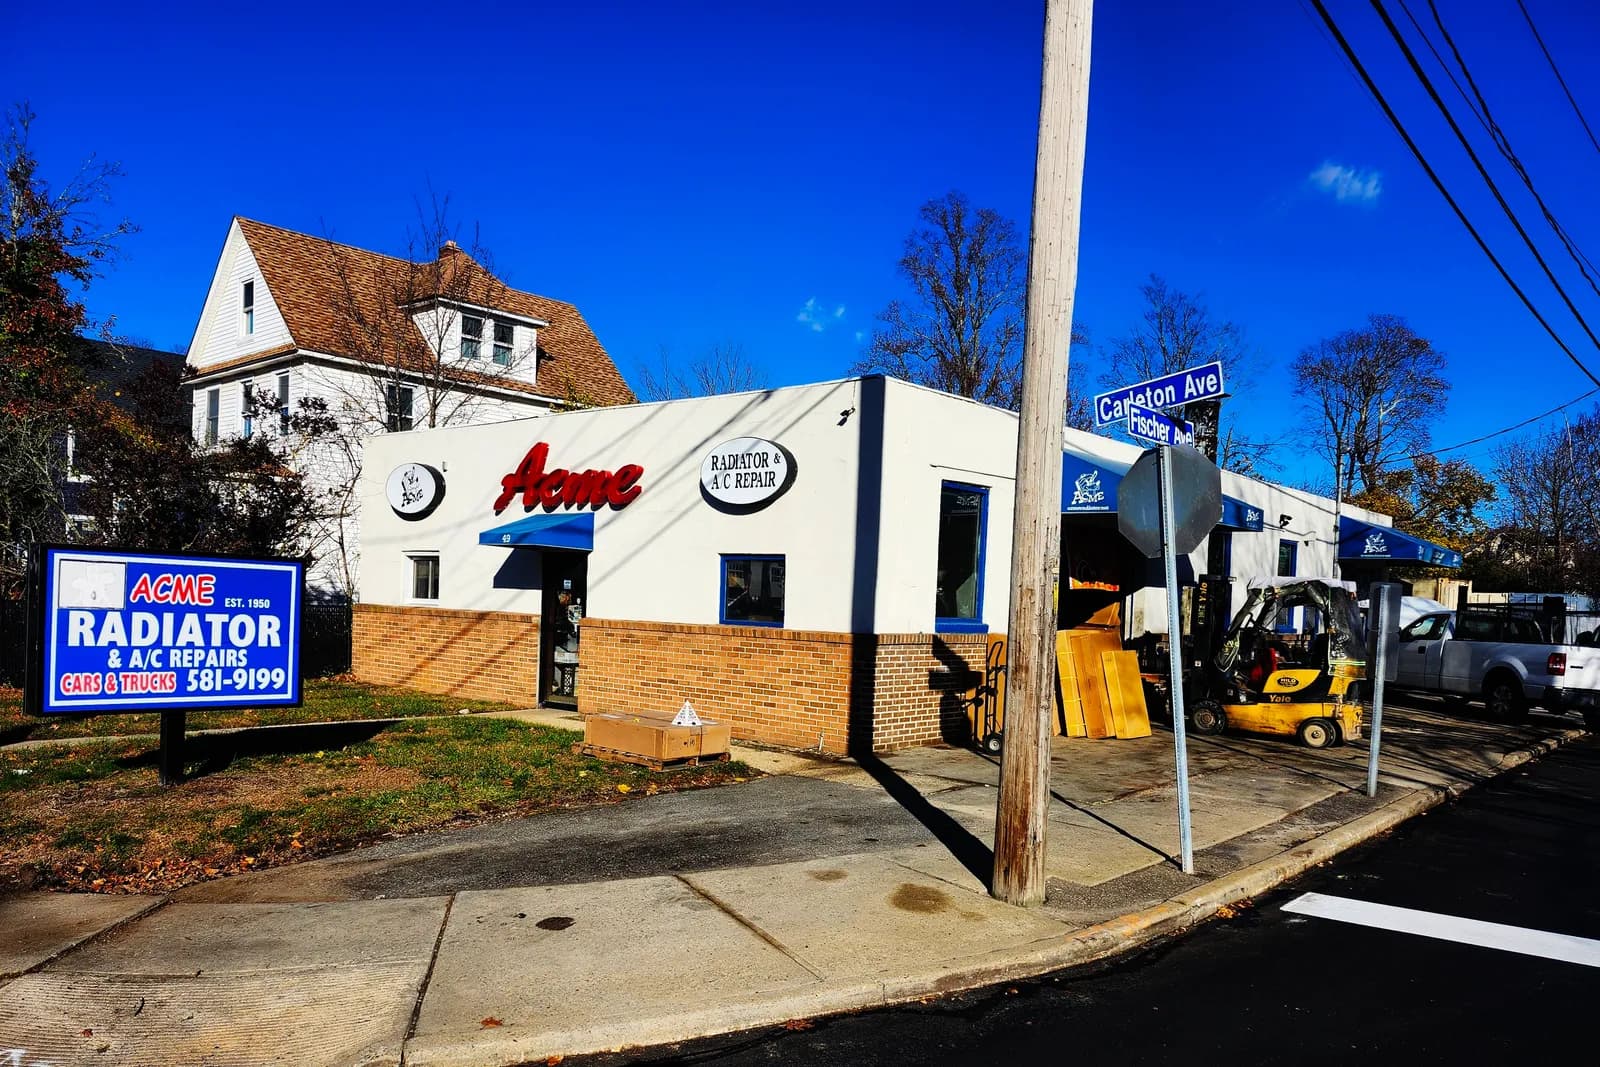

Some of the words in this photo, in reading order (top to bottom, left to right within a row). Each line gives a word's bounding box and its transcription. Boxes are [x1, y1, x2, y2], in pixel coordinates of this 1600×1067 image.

[1184, 374, 1218, 399] Ave
[1130, 407, 1170, 442] Fischer
[1174, 427, 1193, 446] Ave
[711, 452, 769, 471] RADIATOR
[773, 453, 781, 464] &
[493, 442, 644, 512] Acme
[711, 473, 731, 490] A/C
[735, 471, 776, 488] REPAIR
[502, 534, 511, 543] 49
[130, 573, 216, 606] ACME
[224, 598, 245, 608] EST.
[247, 599, 270, 609] 1950
[68, 611, 281, 648] RADIATOR
[108, 649, 122, 668] &
[129, 649, 162, 670] A/C
[170, 649, 248, 668] REPAIRS
[60, 673, 101, 695] CARS
[104, 672, 119, 694] &
[121, 672, 177, 694] TRUCKS
[186, 668, 286, 692] 581-9199
[1269, 694, 1292, 702] Yale
